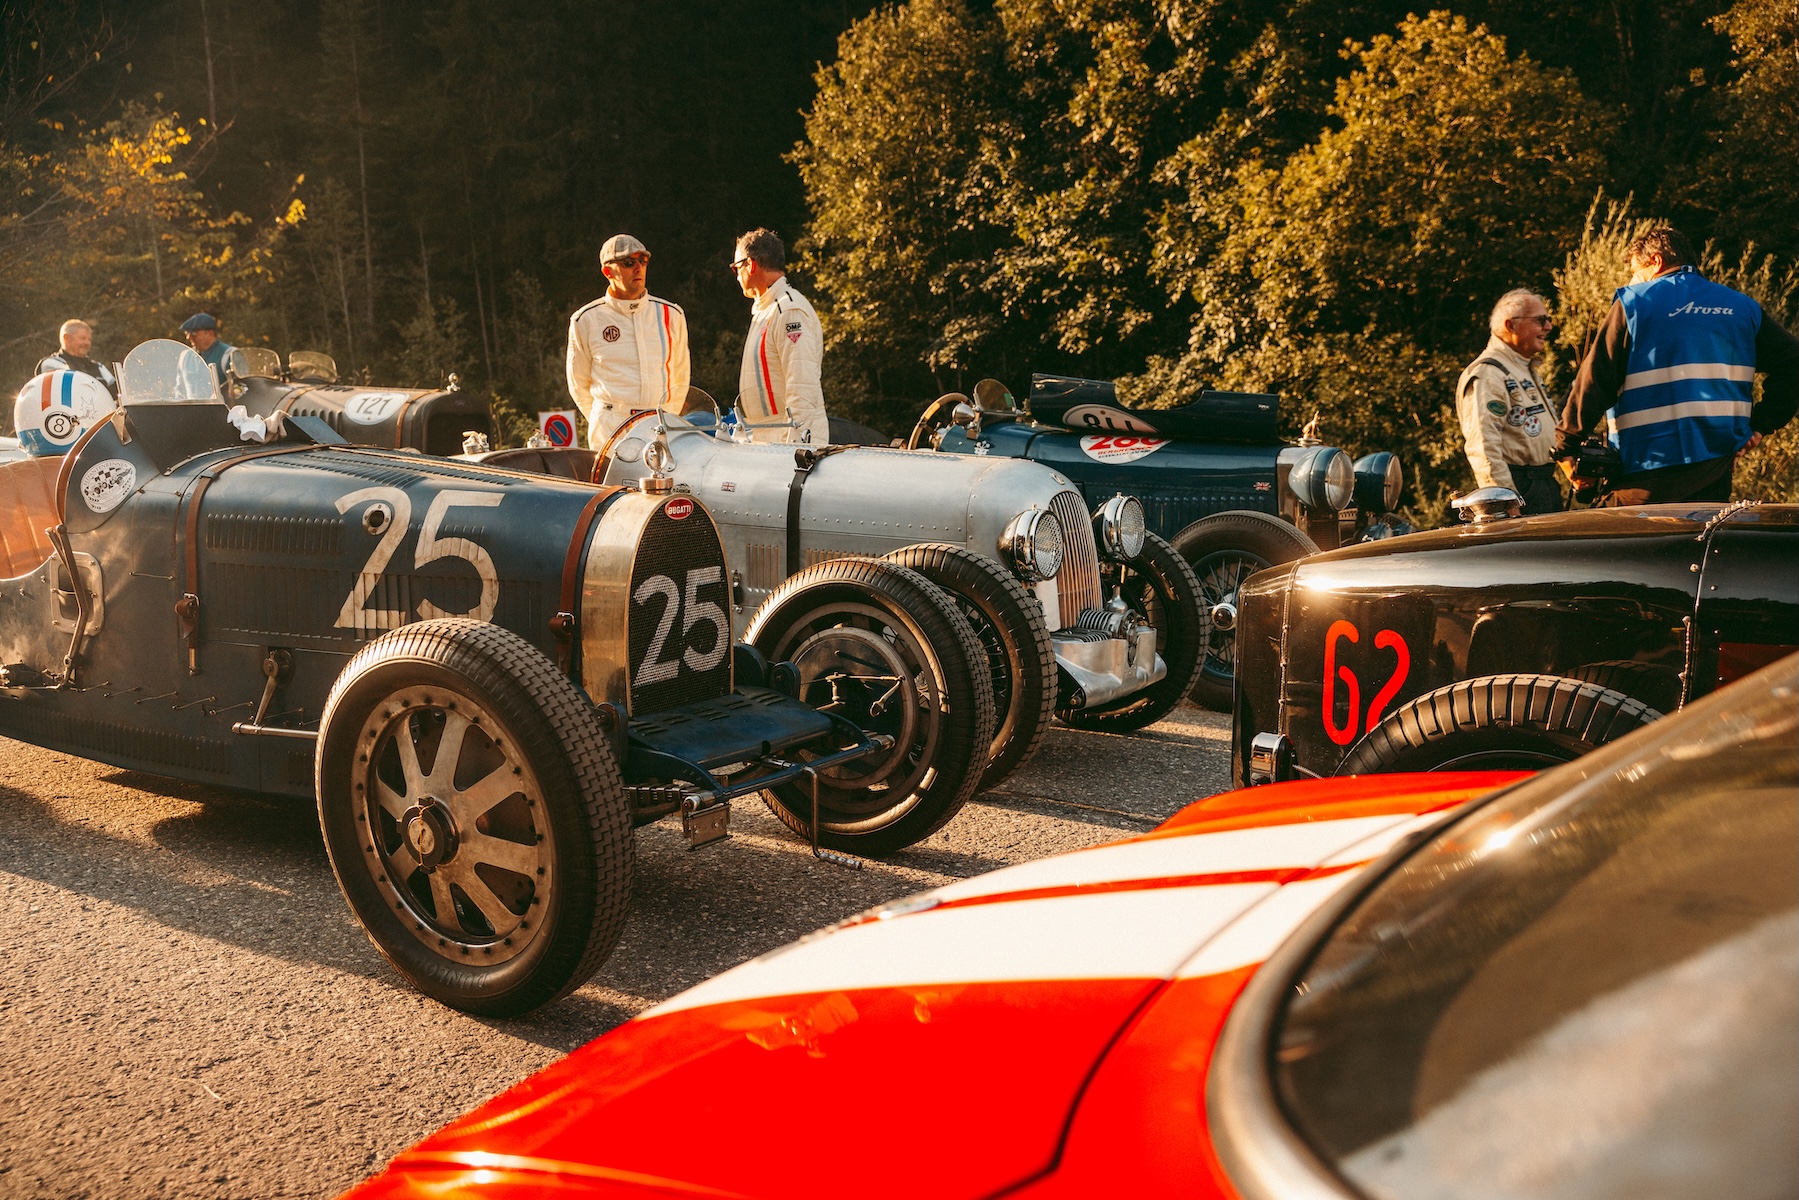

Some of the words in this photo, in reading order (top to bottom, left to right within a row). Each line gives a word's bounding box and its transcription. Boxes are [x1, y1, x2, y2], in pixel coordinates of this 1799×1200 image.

[1668, 301, 1734, 317] Arosa
[356, 397, 392, 416] 121
[53, 418, 65, 433] 8
[668, 505, 691, 515] BUGATTI
[334, 486, 505, 630] 25
[632, 566, 729, 686] 25
[1324, 620, 1411, 745] 62
